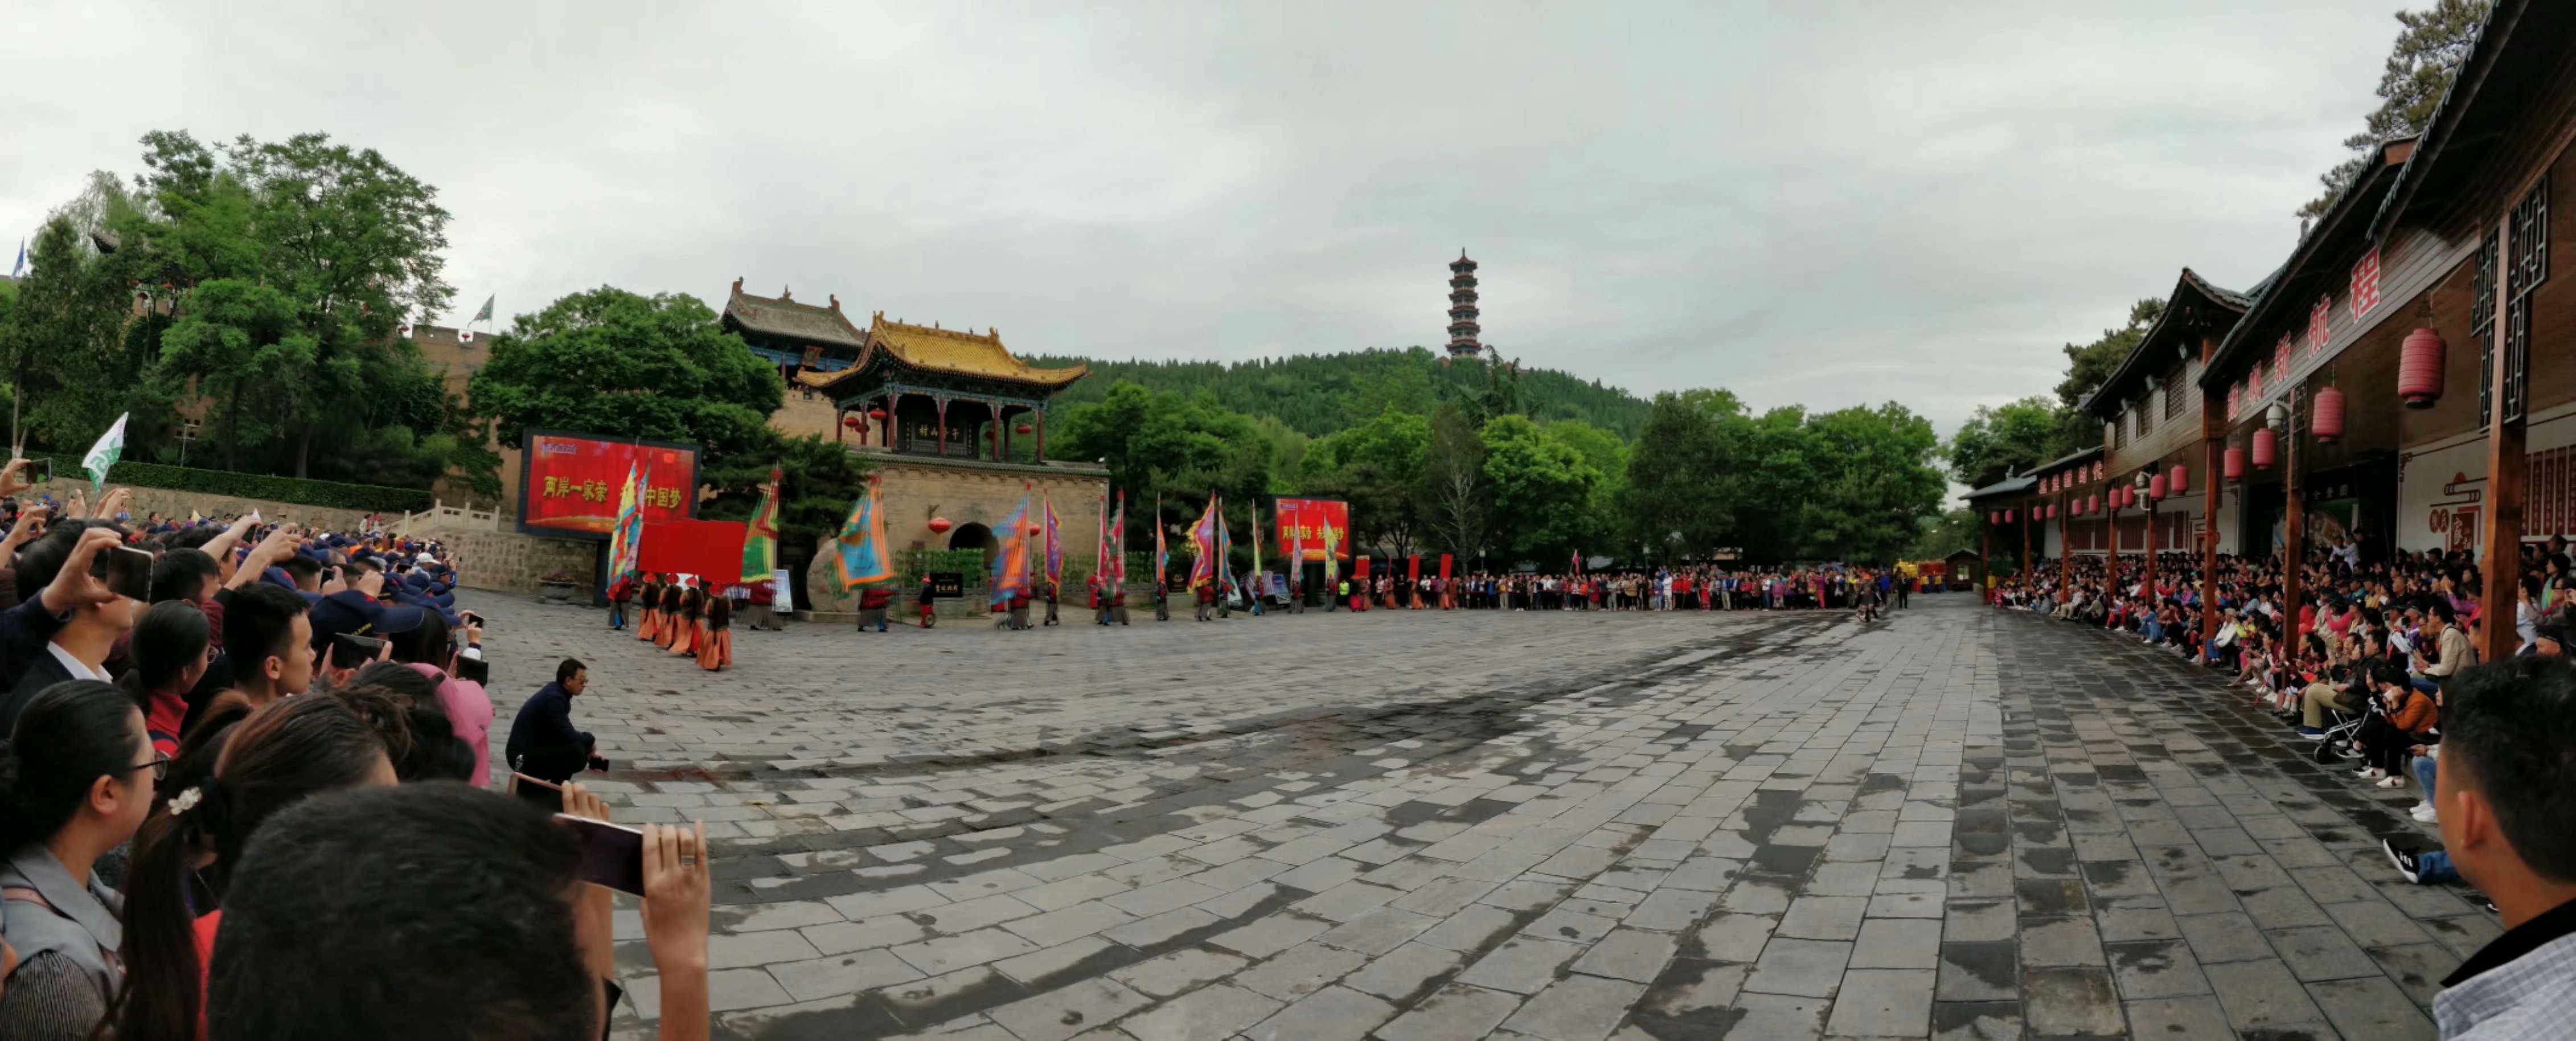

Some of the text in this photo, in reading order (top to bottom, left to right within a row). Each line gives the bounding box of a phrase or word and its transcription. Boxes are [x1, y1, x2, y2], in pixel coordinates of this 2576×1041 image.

[543, 476, 608, 502] 两岸一家亲
